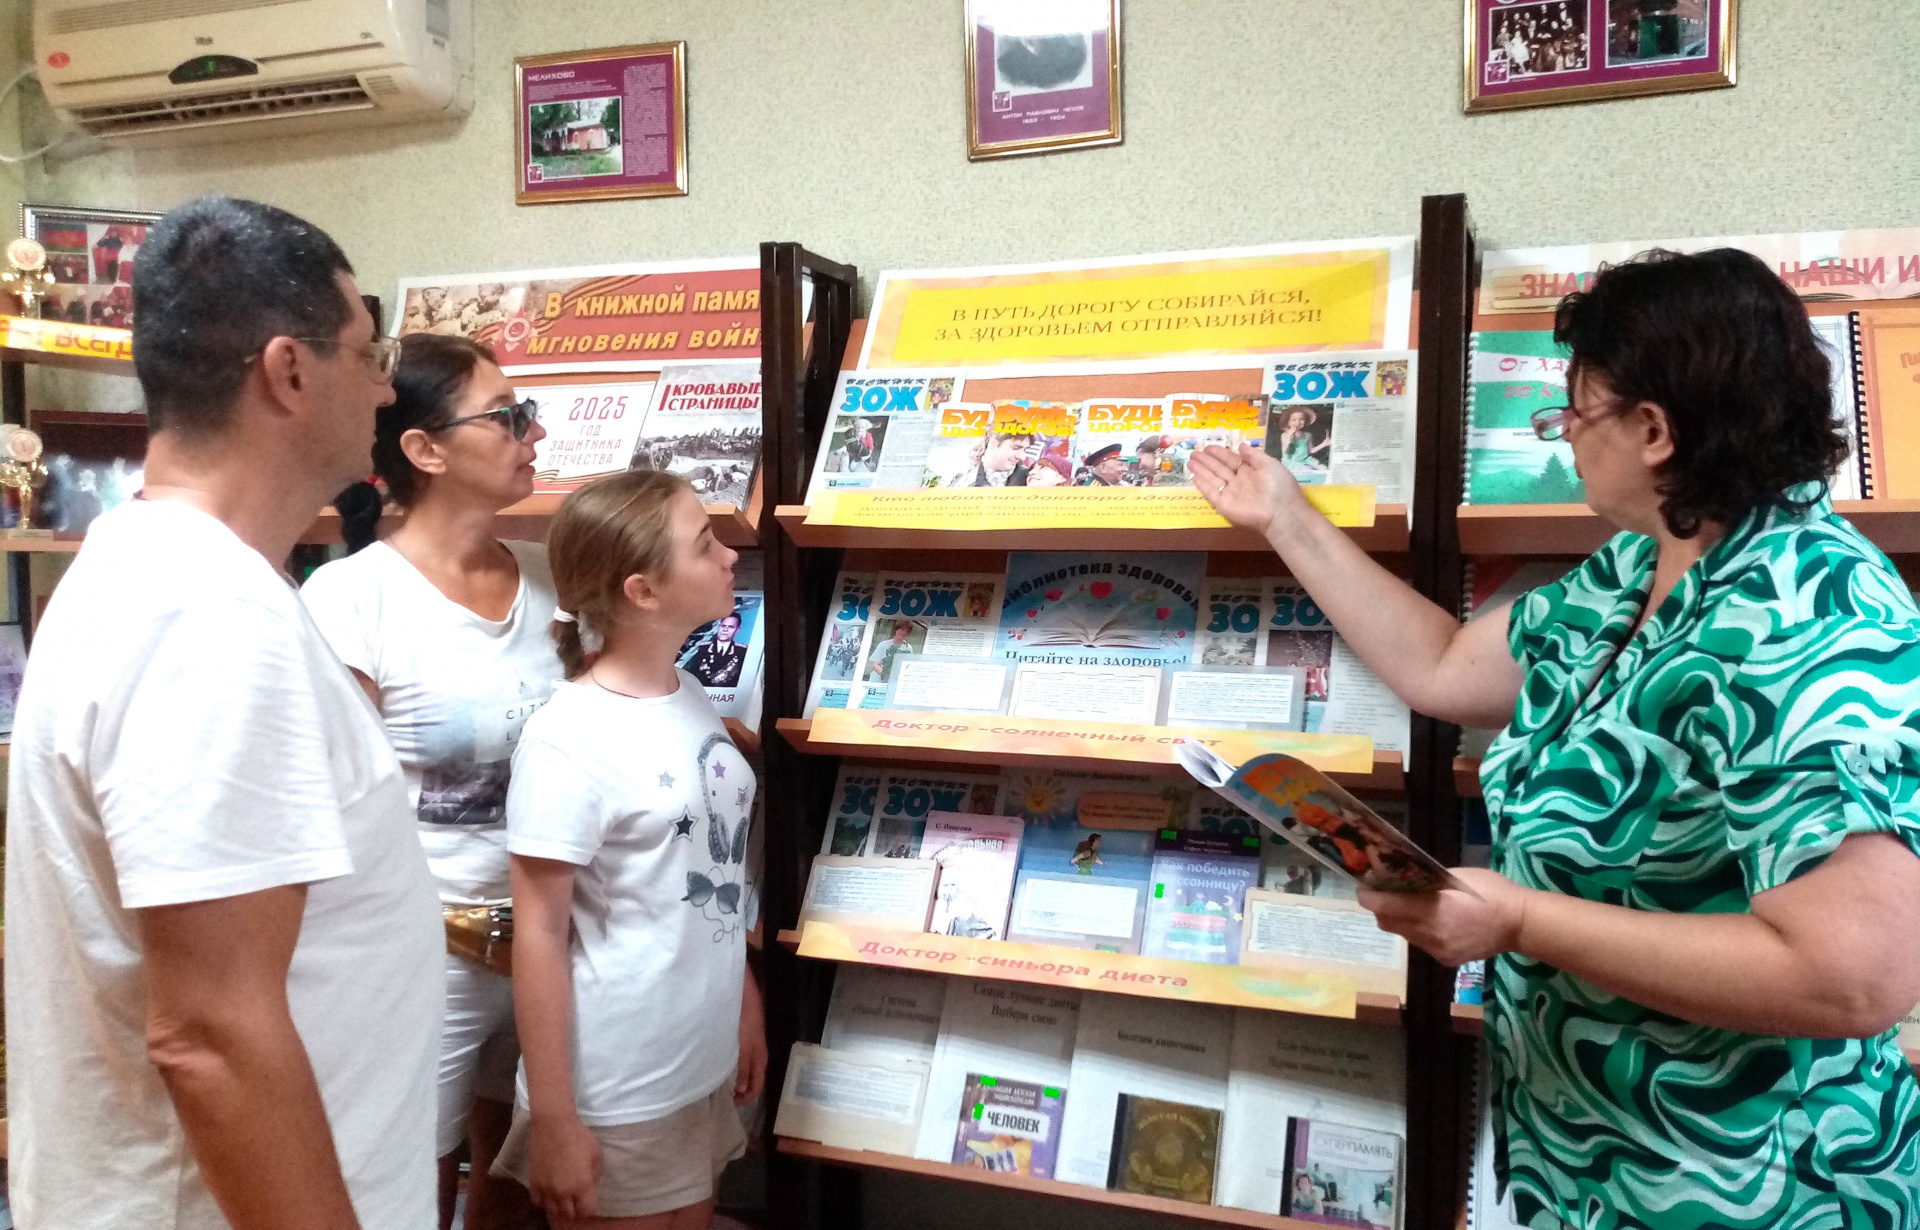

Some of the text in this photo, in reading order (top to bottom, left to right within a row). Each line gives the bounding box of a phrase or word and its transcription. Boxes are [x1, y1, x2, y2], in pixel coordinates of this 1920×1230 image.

[528, 71, 575, 82] МЕЛИХОВО
[1780, 257, 1884, 288] НАШИ
[1899, 254, 1920, 283] И
[544, 291, 562, 318] В
[952, 289, 1311, 321] В ПУТЬ ДОРОГУ СОБИРАЙСЯ,
[526, 321, 760, 355] мгновения войн
[935, 309, 1322, 343] ЗА ЗДОРОВЬЕМ ОТПРАВЛЯЙСЯ!
[1274, 361, 1374, 372] ВЕСТНИК
[672, 382, 762, 396] КРОВАВЫЕ
[846, 378, 927, 387] ВЕСТНИК
[1272, 371, 1370, 401] ЗОЖ
[568, 396, 629, 421] 2025
[668, 396, 760, 411] СТРАНИЦЫ
[840, 386, 924, 413] ЗОЖ
[580, 425, 601, 436] ГОД
[549, 438, 622, 452] ЗАЩИТНИКА
[547, 453, 613, 466] ОТЕЧЕСТВА
[1026, 494, 1126, 502] доктора
[879, 588, 963, 617] ЗОЖ
[1271, 596, 1332, 627] ЗО
[1079, 656, 1095, 665] на
[872, 719, 968, 734] Доктор
[1157, 737, 1223, 747] свт
[883, 786, 967, 817] ЗОЖ
[1187, 862, 1250, 877] победить
[858, 940, 957, 963] Доктор
[1098, 967, 1188, 987] диета
[987, 1110, 1041, 1133] ЧЕЛОВЕК
